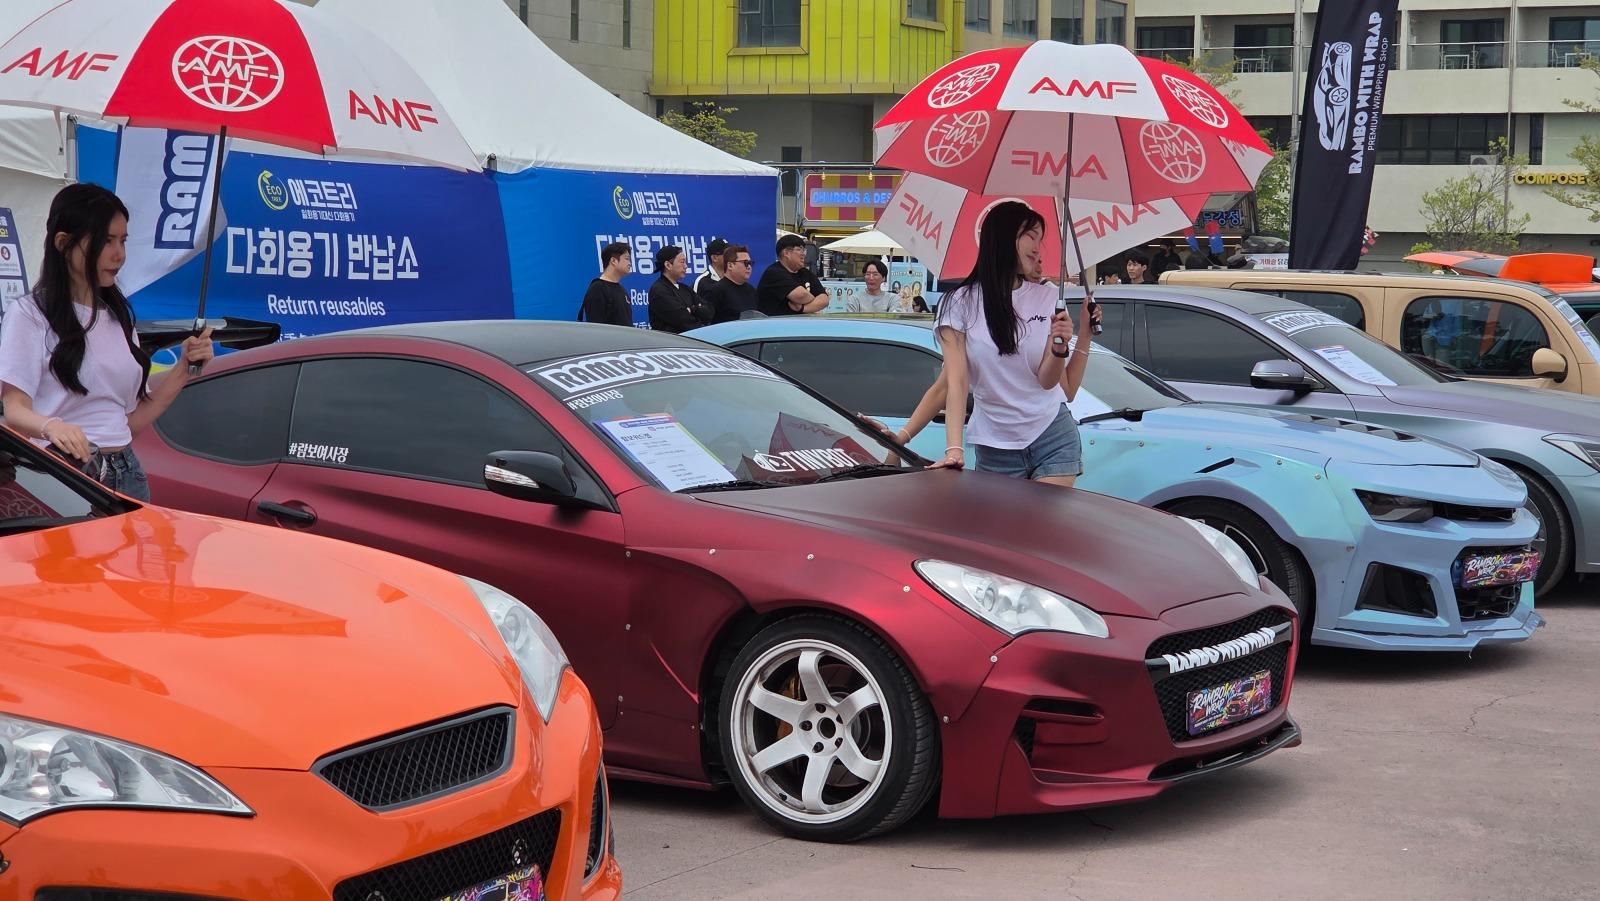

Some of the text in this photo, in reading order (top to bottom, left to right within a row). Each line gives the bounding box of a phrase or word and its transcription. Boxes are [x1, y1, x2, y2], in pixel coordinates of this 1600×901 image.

[0, 47, 119, 80] AMF
[181, 55, 271, 82] AMF
[935, 74, 992, 94] AMF
[1028, 77, 1137, 100] AMF
[1348, 11, 1383, 174] RAMBO WITH WRAP
[1368, 37, 1389, 151] PREMIUM WRAPPING SHOP
[349, 89, 438, 132] AMF
[266, 185, 282, 195] ECO
[1513, 172, 1585, 185] COMPOSE
[287, 178, 358, 210] 에코트리
[618, 197, 630, 207] ECO
[633, 191, 680, 216] 에코트리
[812, 191, 860, 205] CHURROS
[863, 192, 871, 204] &
[226, 226, 419, 281] 다회용기 반납소
[267, 294, 386, 317] Return reusables
[1026, 315, 1048, 324] AMF
[541, 353, 661, 392] RAMBO
[641, 351, 721, 373] WITH
[288, 442, 350, 464] #람보여사장
[779, 448, 861, 472] TINYBOT
[1467, 555, 1497, 573] RAMBO
[1162, 647, 1220, 674] RAMBO
[1213, 636, 1251, 662] WITH
[1193, 685, 1225, 713] RAMBO
